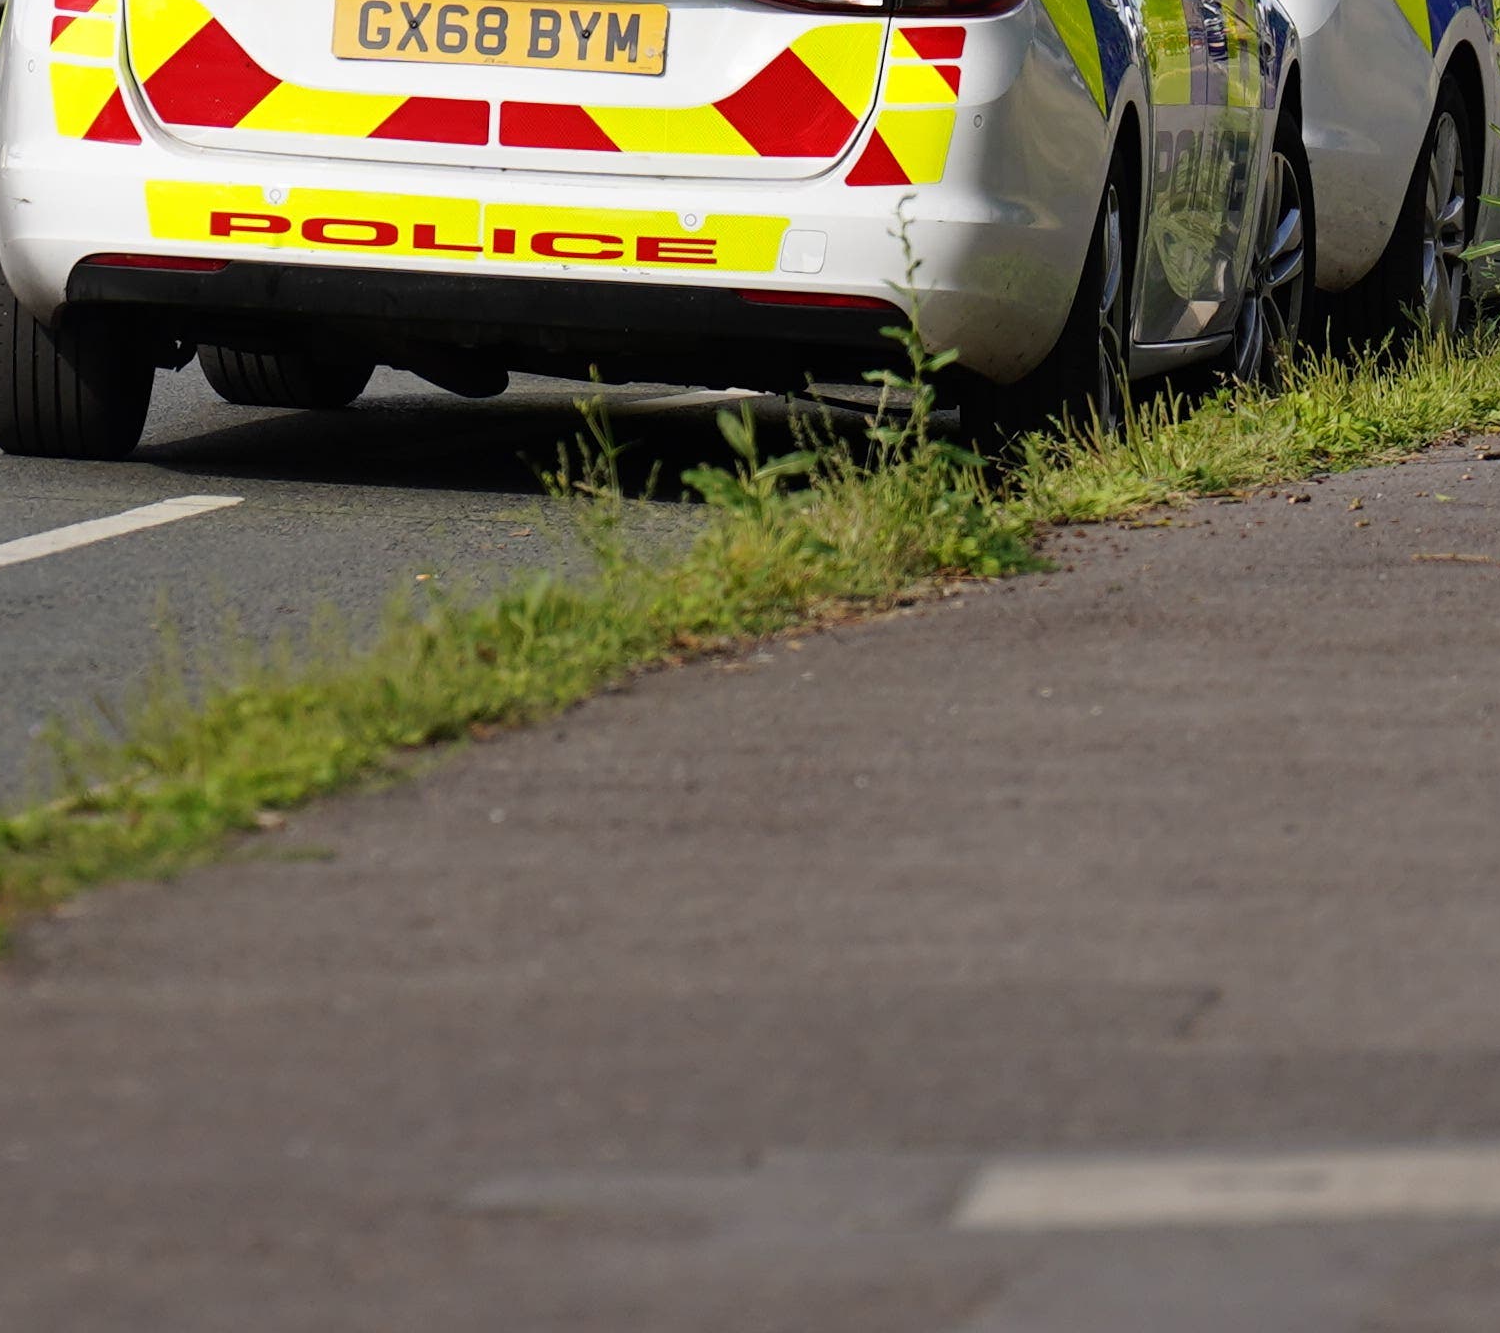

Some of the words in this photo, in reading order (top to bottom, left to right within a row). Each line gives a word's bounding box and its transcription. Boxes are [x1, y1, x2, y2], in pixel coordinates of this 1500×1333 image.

[357, 0, 509, 57] GX68
[527, 7, 641, 64] BYM
[1154, 129, 1250, 212] POLICE
[209, 210, 718, 265] POLICE
